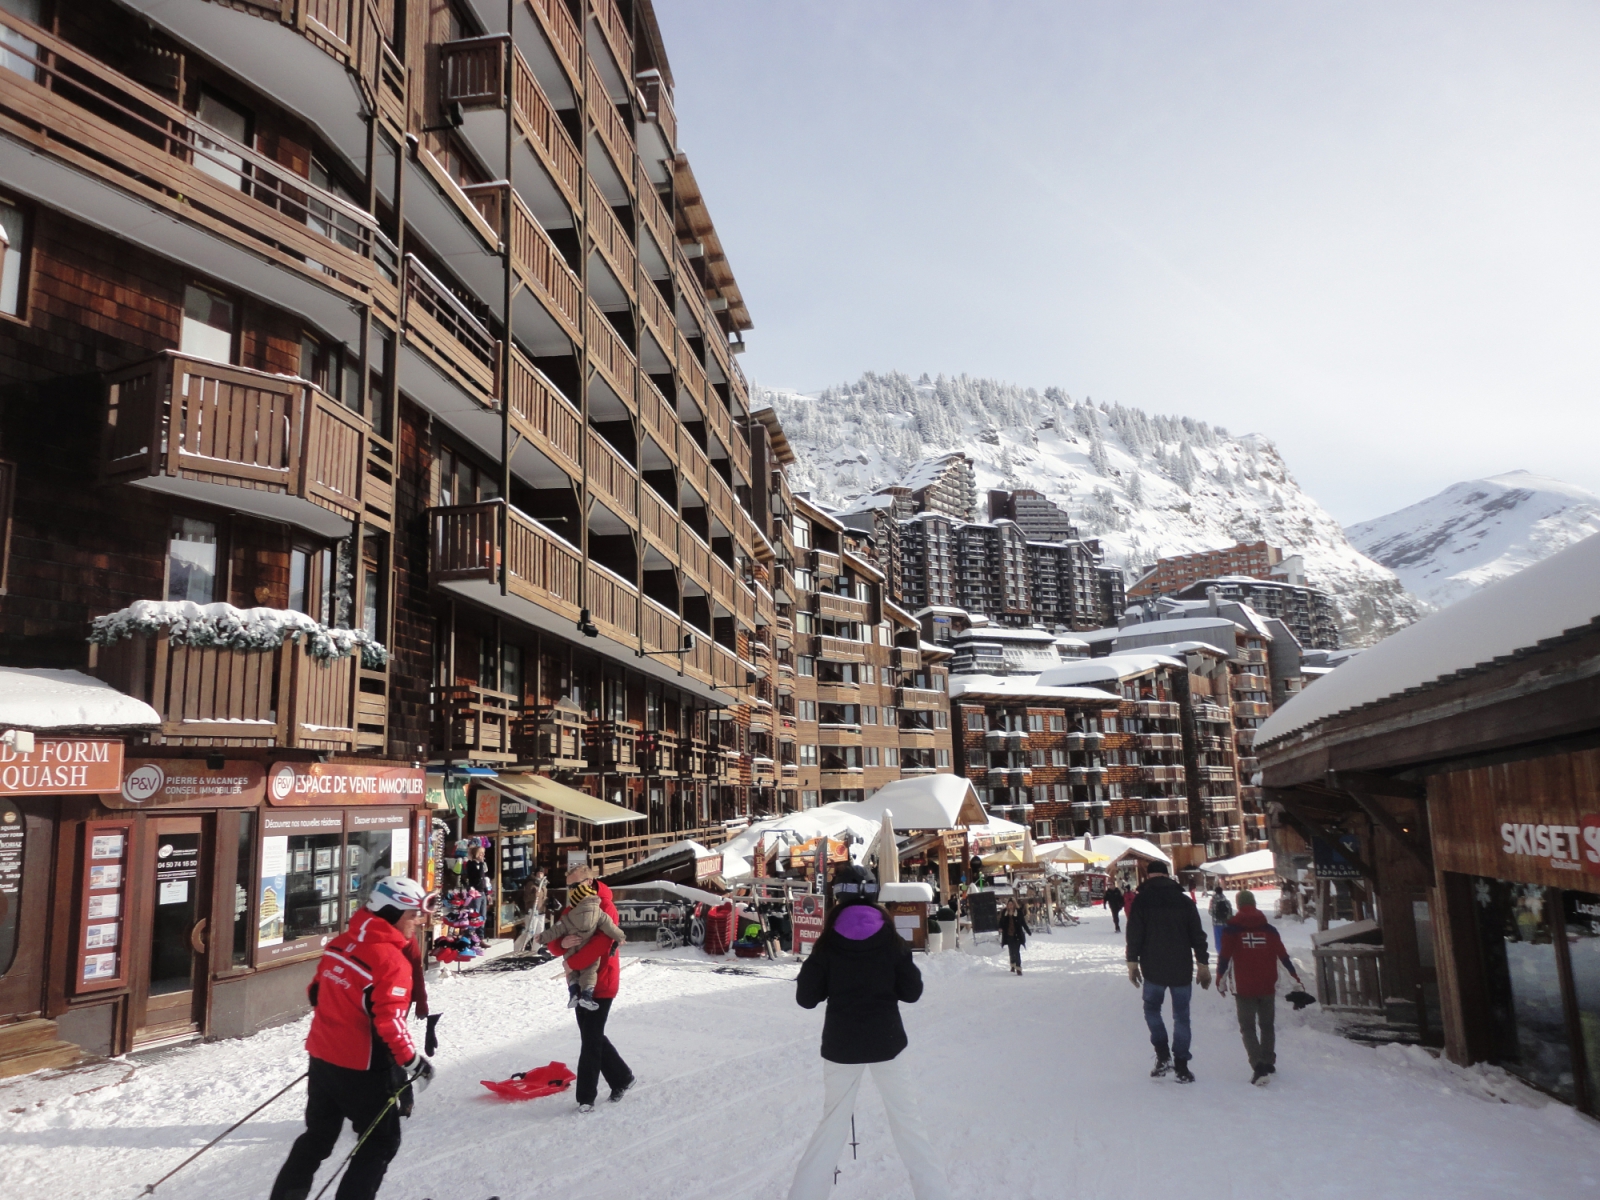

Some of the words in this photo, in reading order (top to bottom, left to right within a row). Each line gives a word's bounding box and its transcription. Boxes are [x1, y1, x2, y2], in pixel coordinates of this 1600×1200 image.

[40, 741, 110, 762] FORM
[0, 765, 88, 790] QUASH
[130, 777, 157, 791] P&V
[166, 776, 197, 785] PIERRE
[199, 777, 204, 785] &
[206, 777, 248, 785] VACANCES
[165, 786, 198, 795] CONSEIL
[199, 786, 242, 795] IMMOBILIER
[295, 775, 332, 793] ESPACE
[334, 776, 348, 794] DE
[349, 776, 377, 794] VENTE
[378, 777, 424, 794] IMMOBILIER
[265, 818, 291, 829] Découvrez
[291, 820, 300, 828] nos
[300, 818, 321, 828] nouvelles
[321, 816, 342, 826] résidences
[354, 815, 371, 825] Discover
[1501, 822, 1580, 861] SKISET
[794, 915, 823, 926] LOCATION
